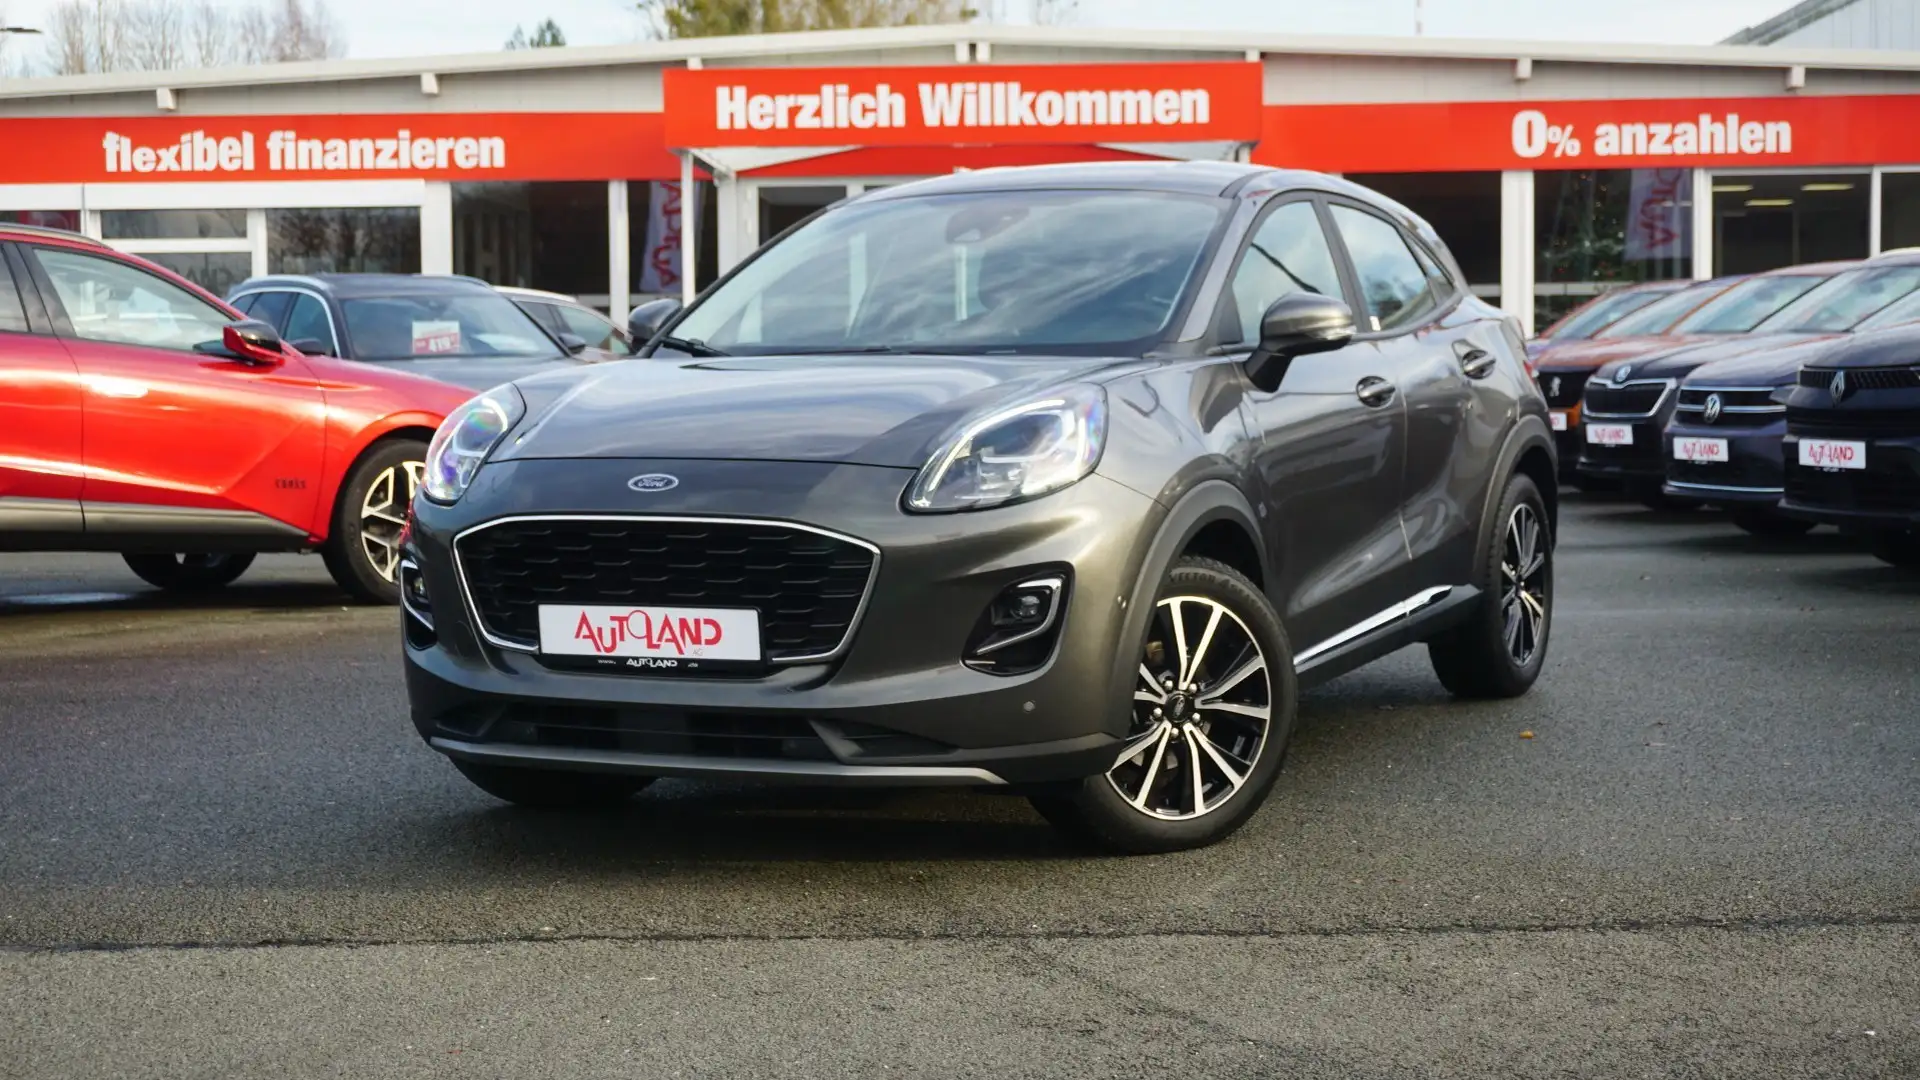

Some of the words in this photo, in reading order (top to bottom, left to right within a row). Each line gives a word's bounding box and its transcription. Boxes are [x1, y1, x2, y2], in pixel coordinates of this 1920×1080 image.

[715, 84, 905, 129] Herzlich
[917, 82, 1210, 128] Willkommen
[102, 129, 255, 172] flexibel
[266, 129, 506, 171] finanzieren
[1511, 109, 1581, 158] 0%
[1594, 113, 1792, 155] anzahlen
[574, 609, 723, 656] AUTOLAND
[626, 657, 678, 668] AUTOLAND
